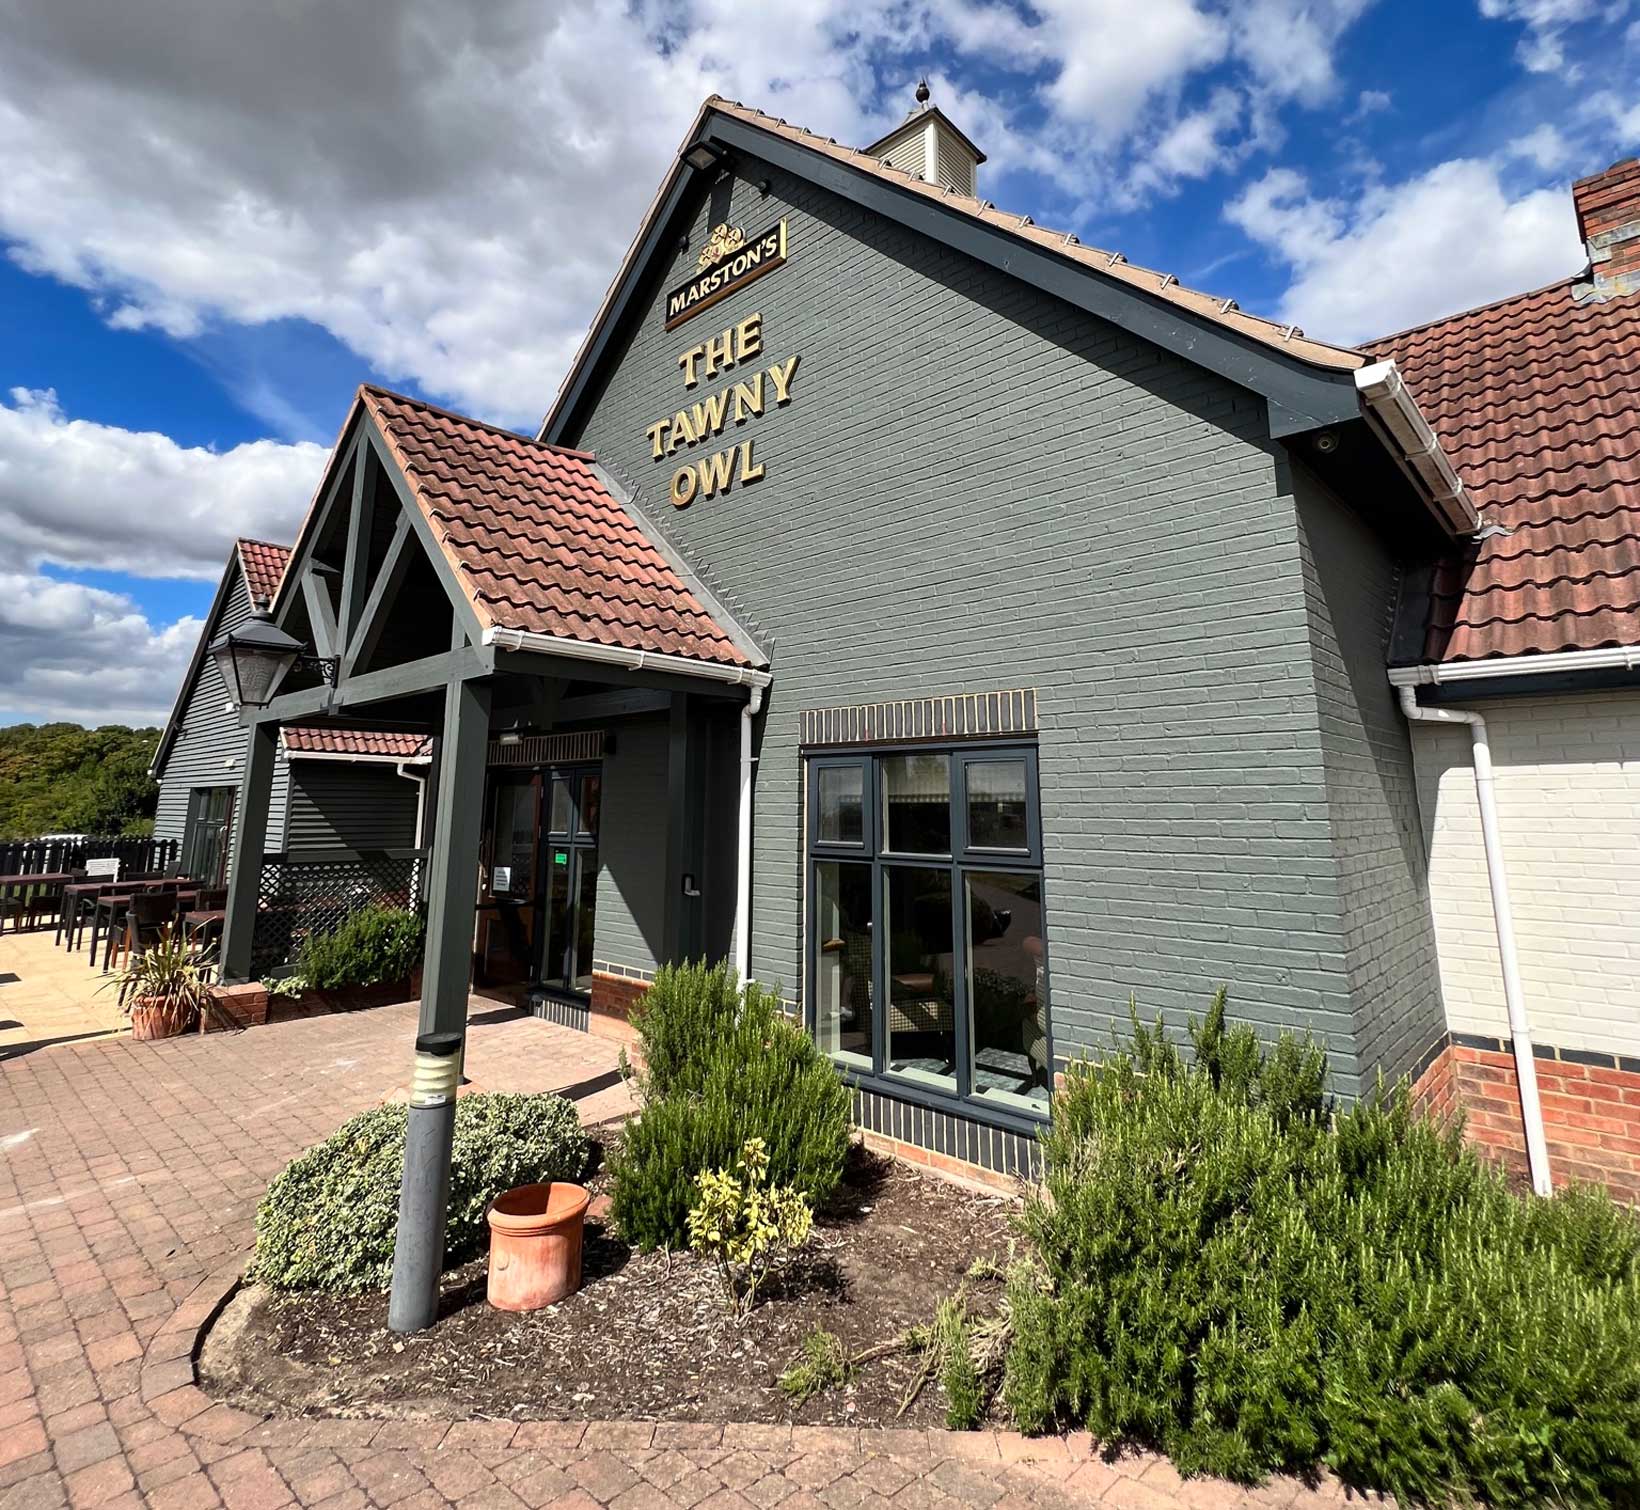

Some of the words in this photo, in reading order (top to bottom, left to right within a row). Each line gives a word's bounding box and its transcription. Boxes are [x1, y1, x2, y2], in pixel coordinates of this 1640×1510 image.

[669, 234, 777, 316] MARSTON'S
[679, 313, 762, 389] THE
[647, 355, 800, 460] TAWNY
[670, 440, 765, 507] OWL
